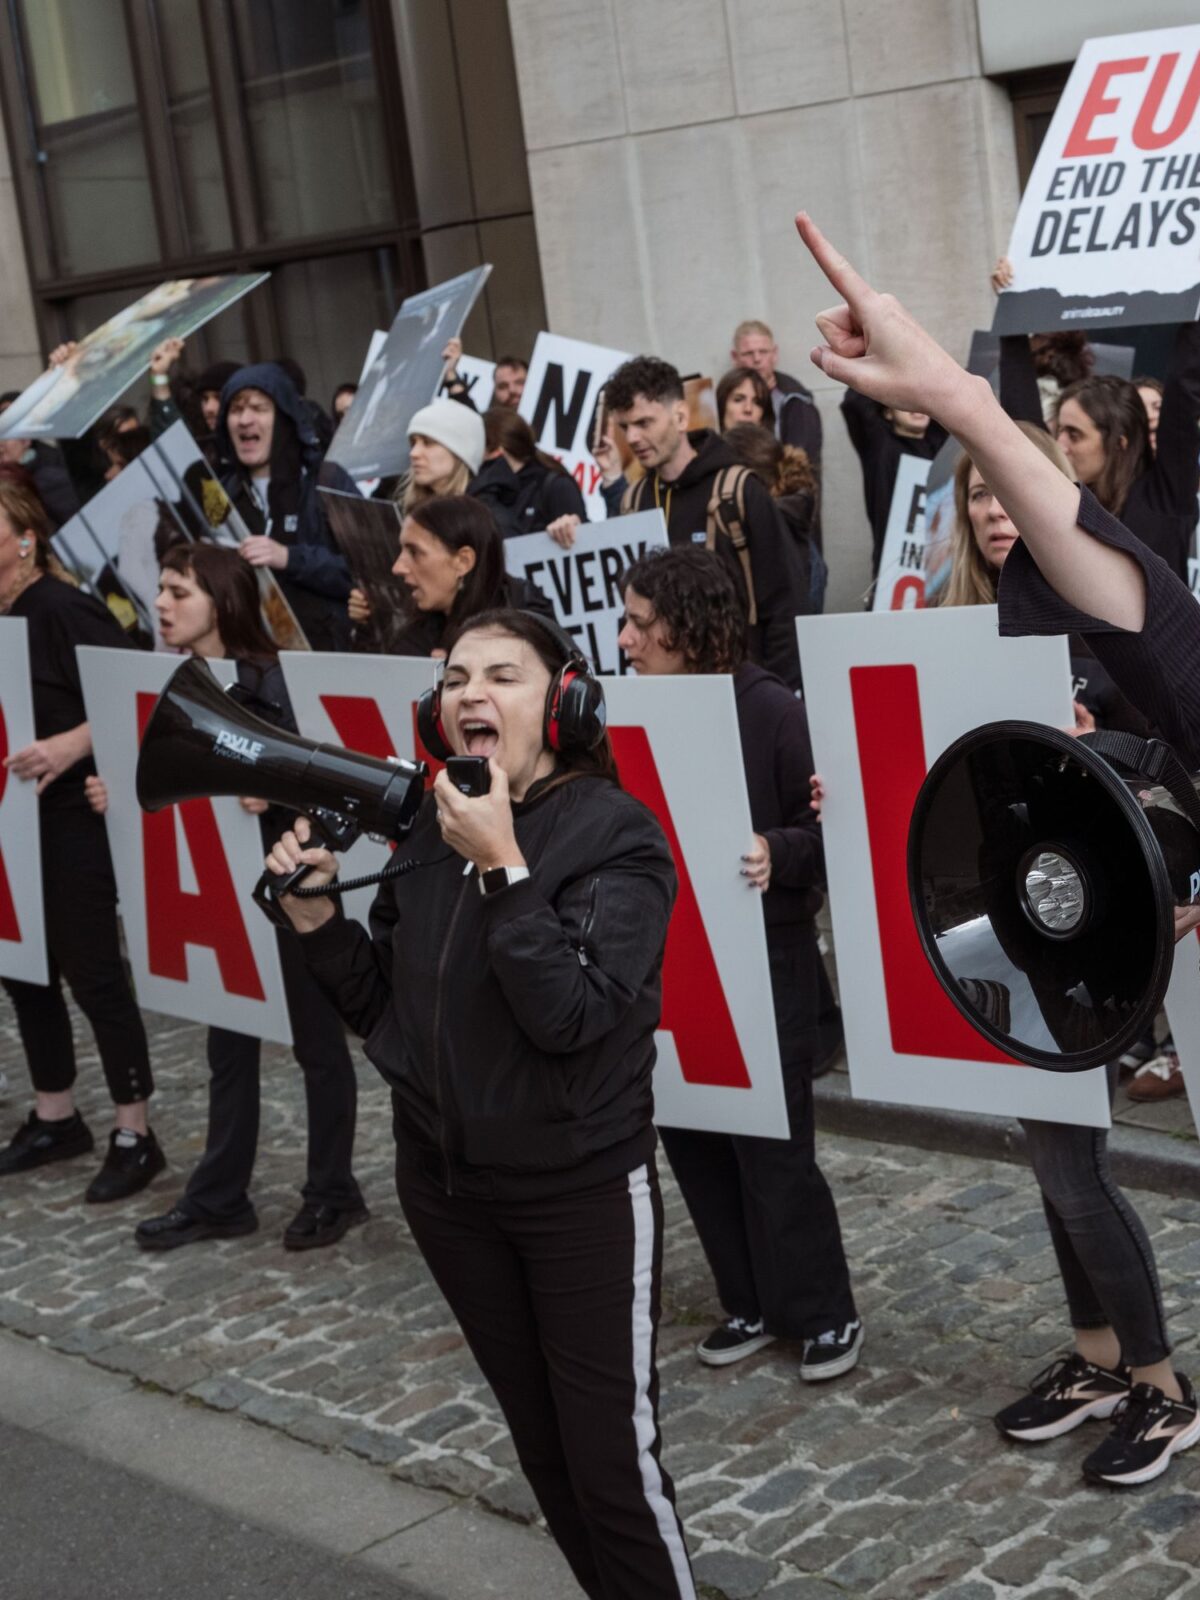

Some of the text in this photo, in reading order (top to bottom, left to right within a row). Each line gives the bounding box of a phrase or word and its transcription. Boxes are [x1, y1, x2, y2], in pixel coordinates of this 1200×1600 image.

[1045, 161, 1126, 202] END
[531, 361, 604, 453] N
[216, 729, 266, 761] PYLE
